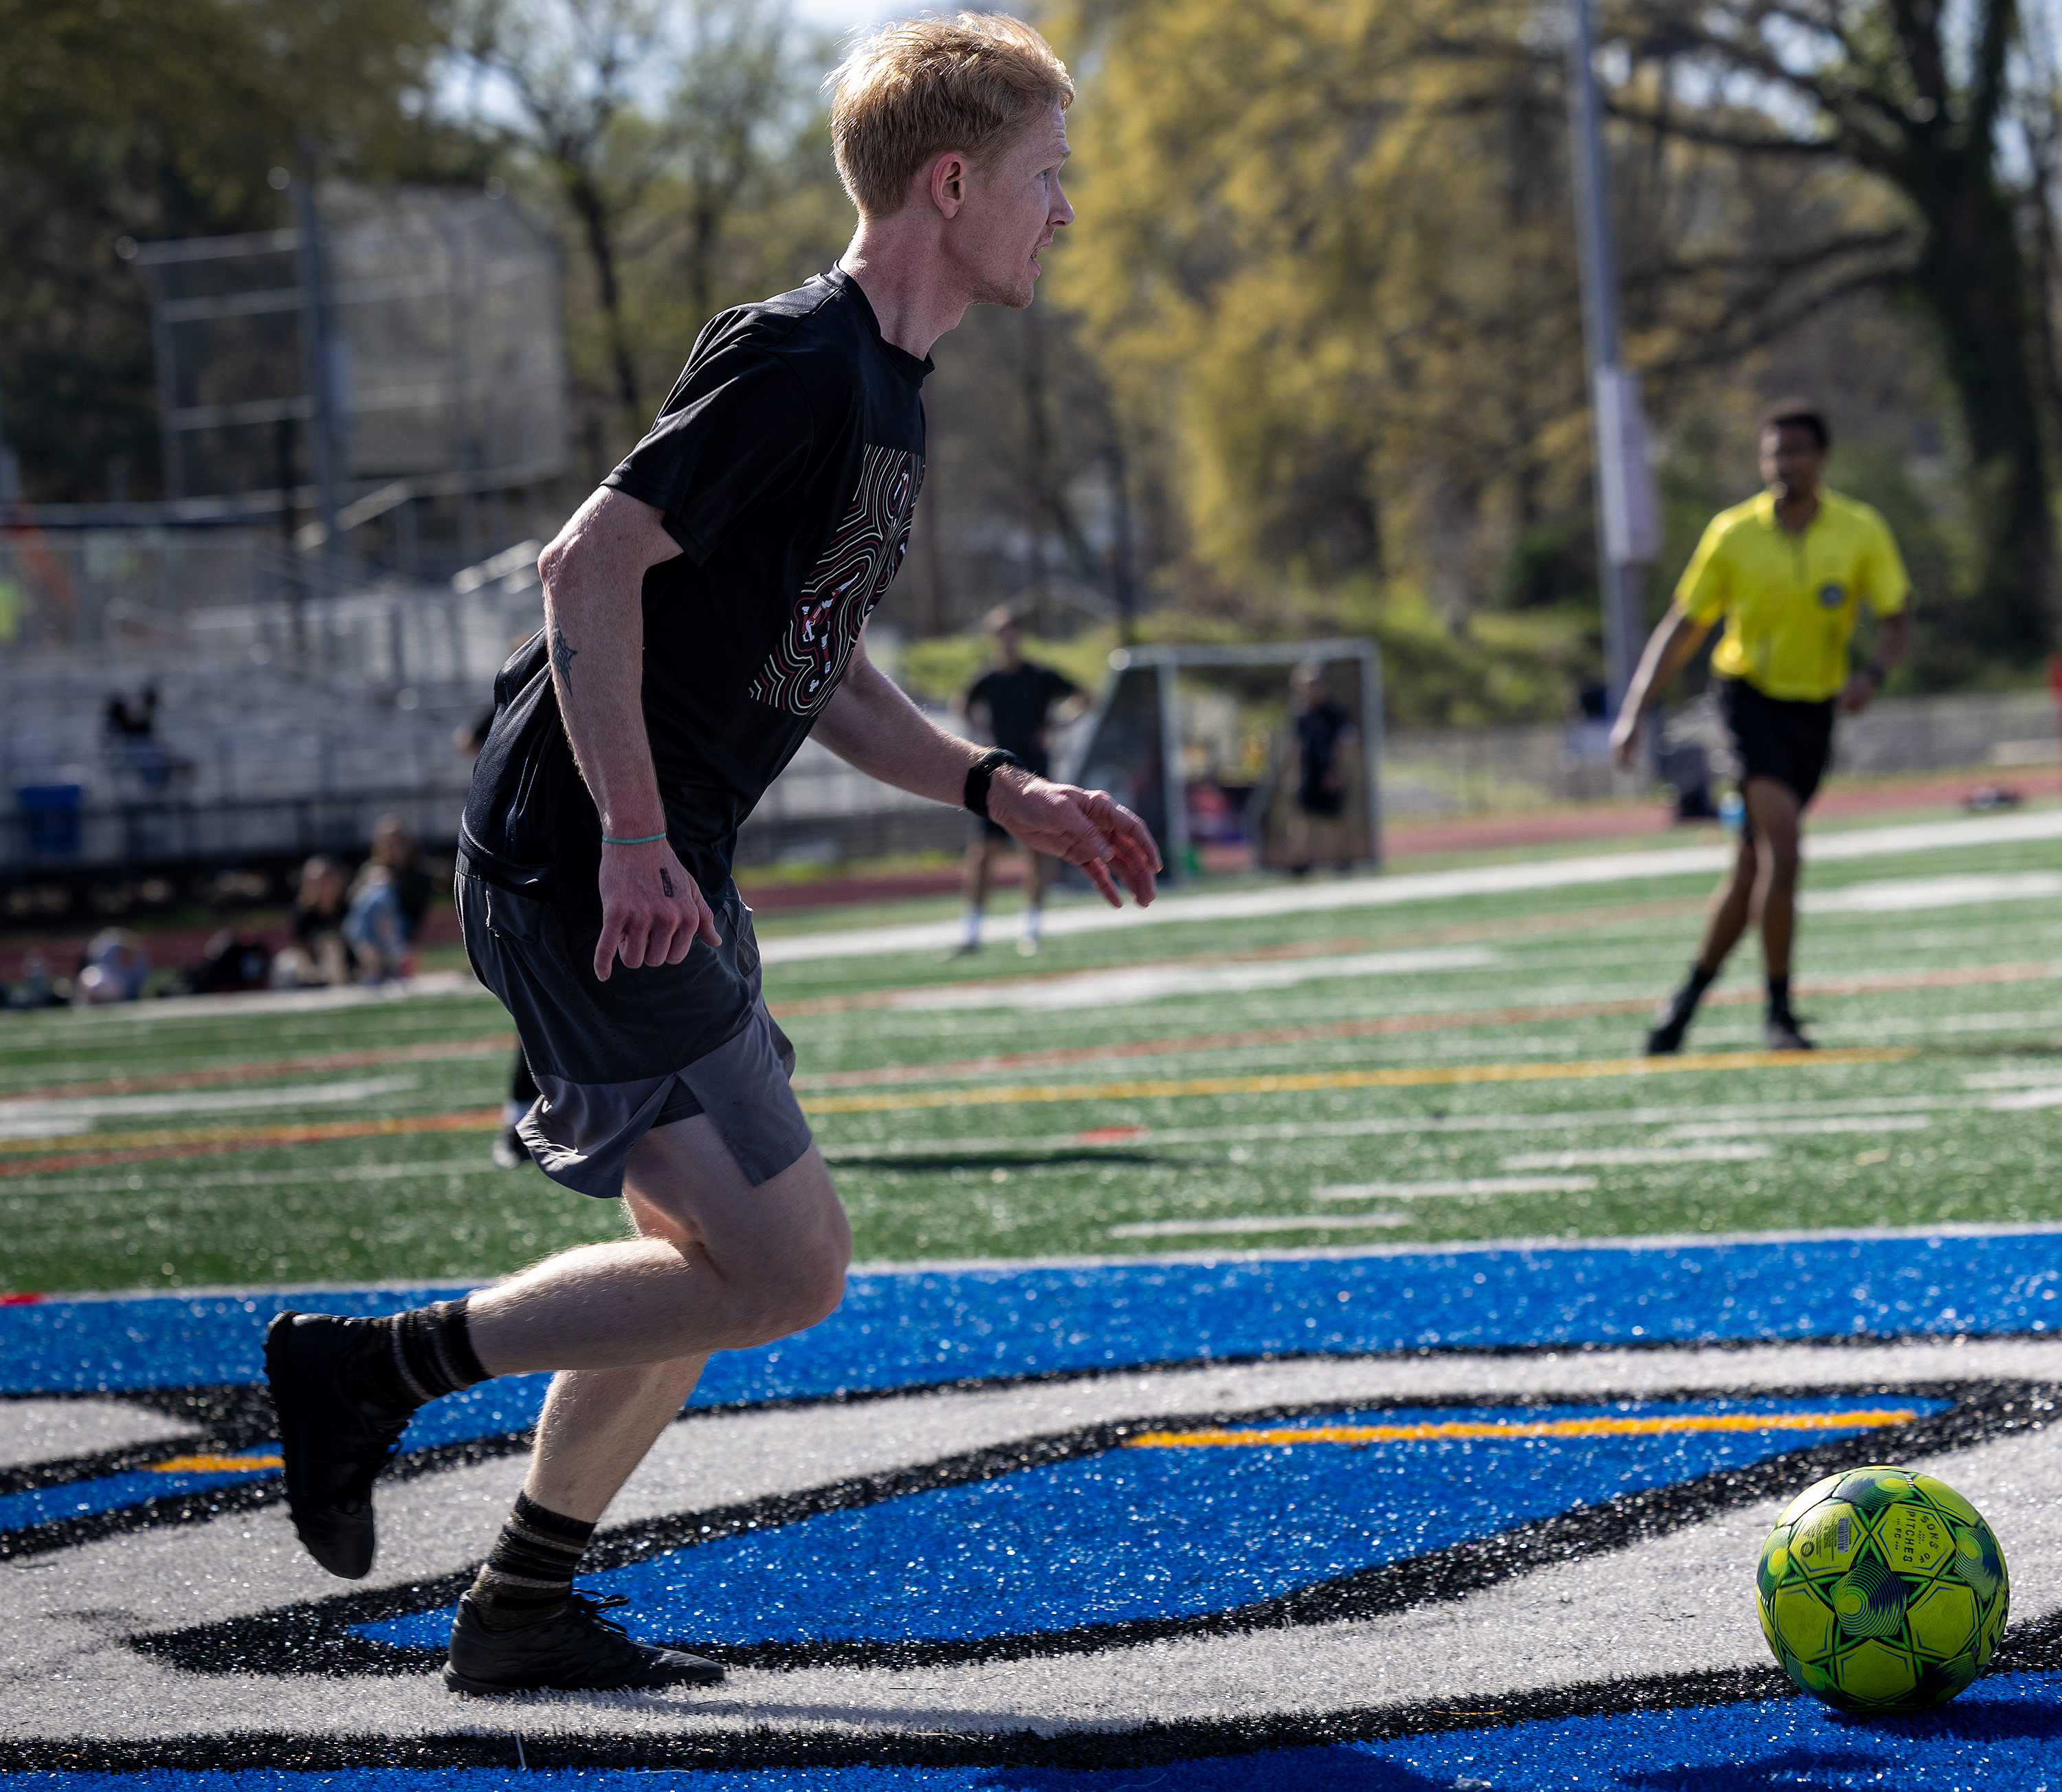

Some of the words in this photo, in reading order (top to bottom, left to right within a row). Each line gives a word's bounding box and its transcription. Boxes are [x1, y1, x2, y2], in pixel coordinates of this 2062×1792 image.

[1894, 1527, 1902, 1538] FC
[1903, 1511, 1916, 1562] PITCHES
[1920, 1516, 1939, 1549] SONS
[1920, 1553, 1931, 1563] OF
